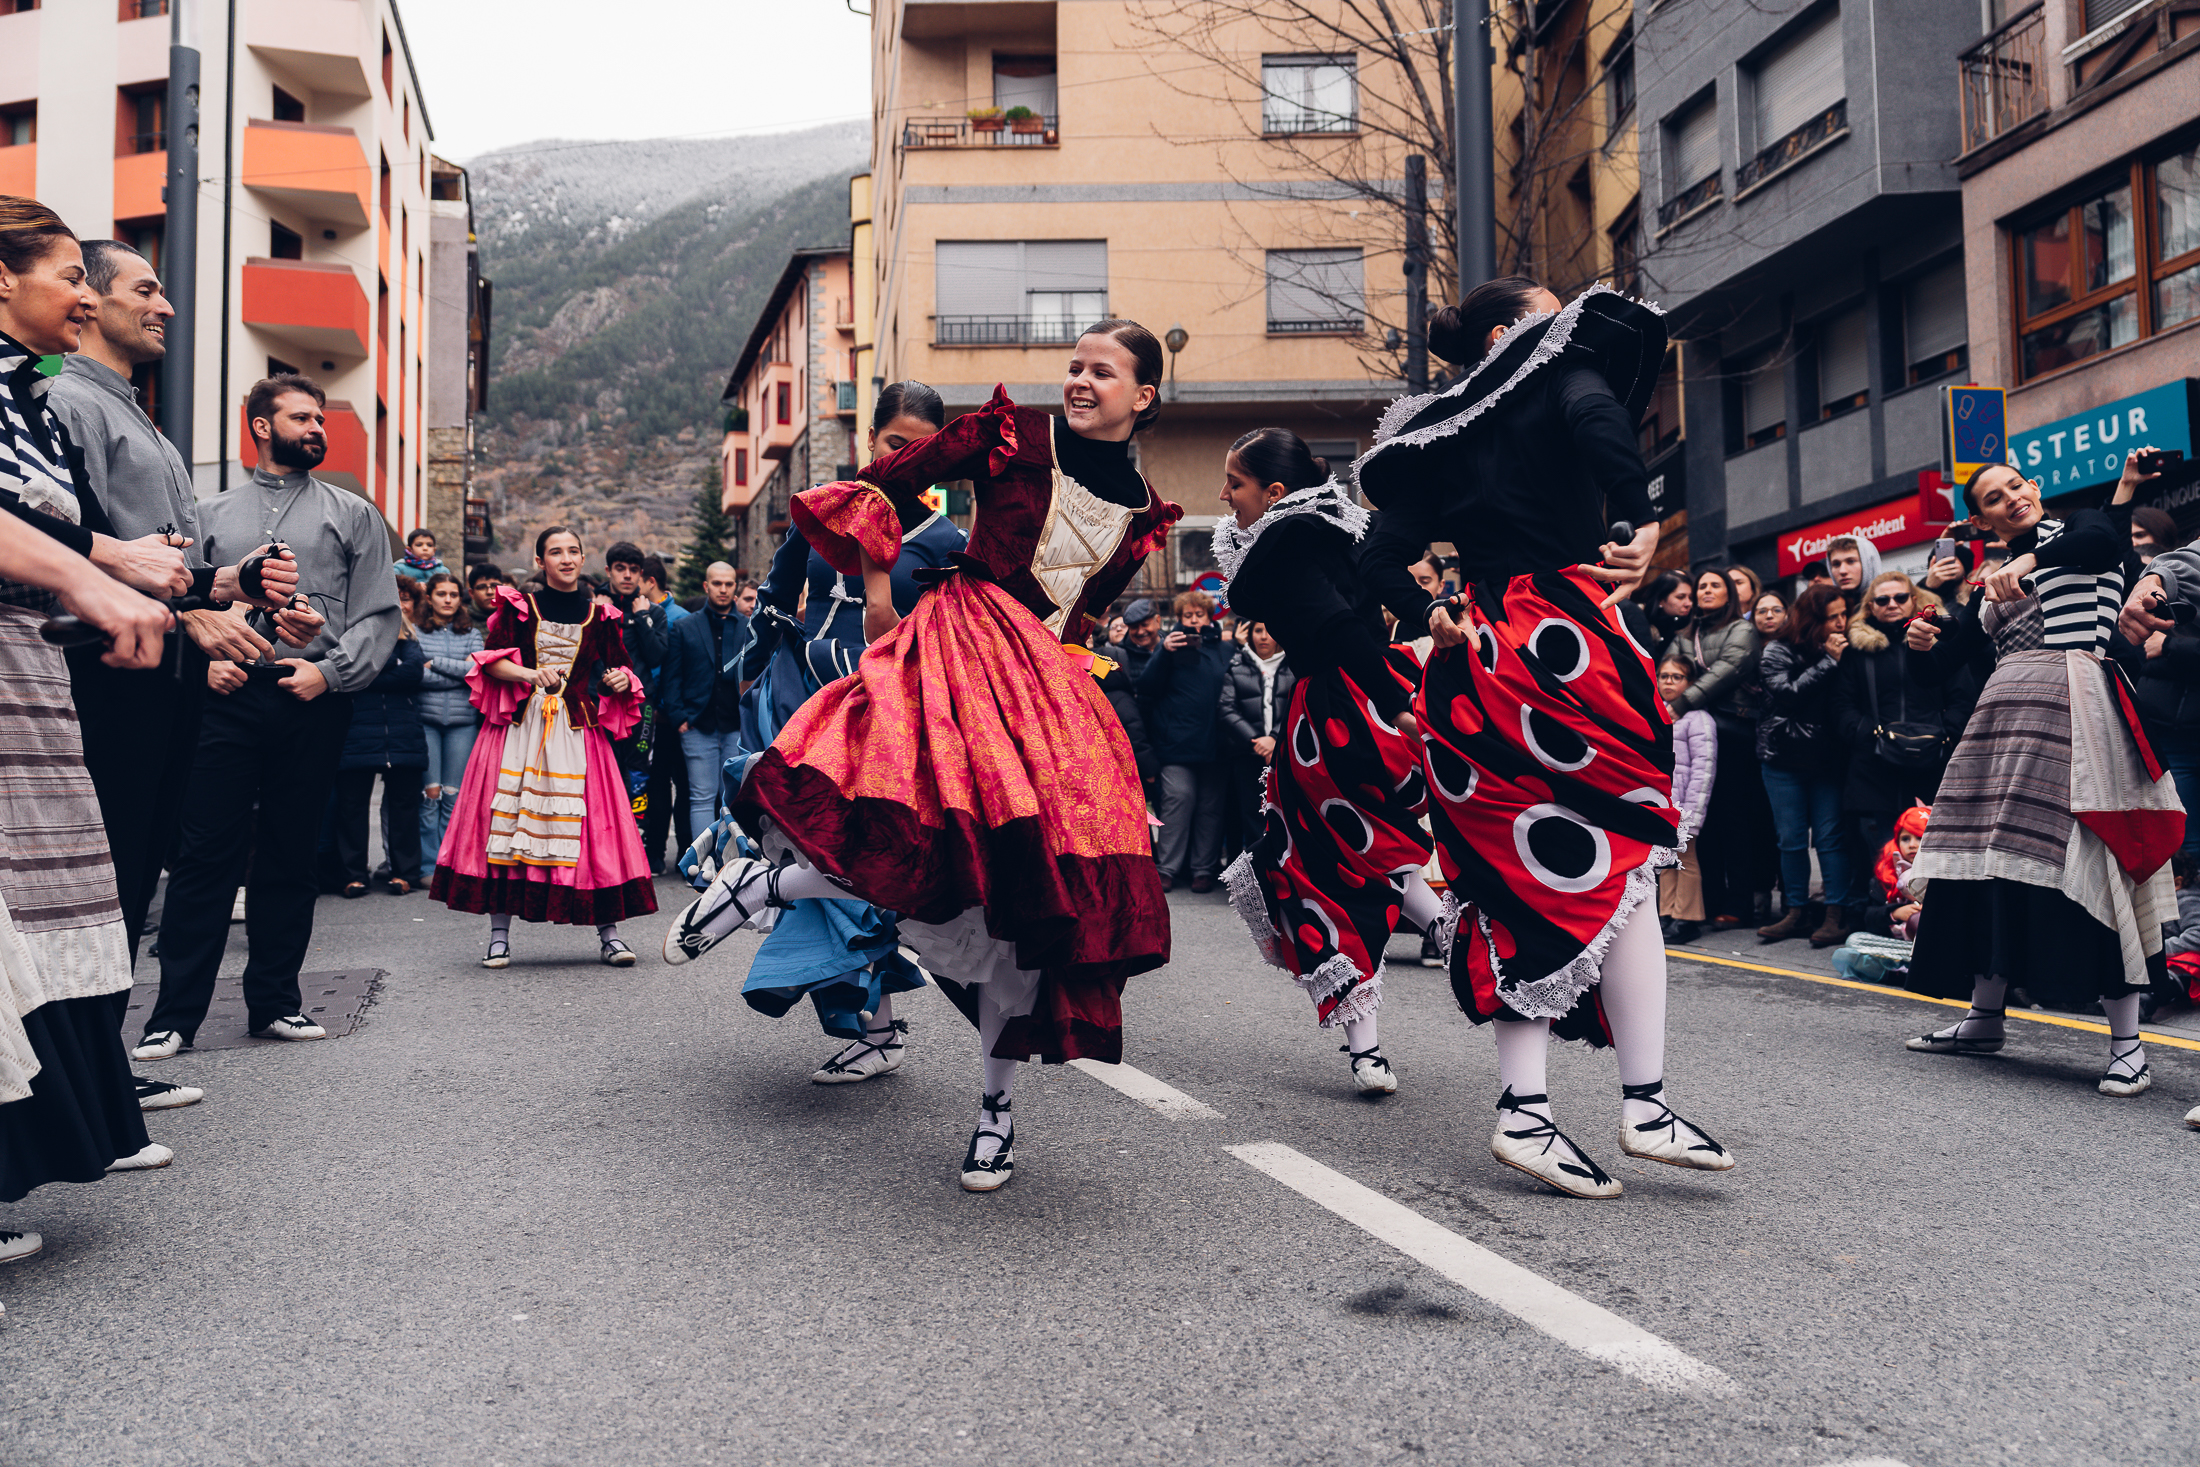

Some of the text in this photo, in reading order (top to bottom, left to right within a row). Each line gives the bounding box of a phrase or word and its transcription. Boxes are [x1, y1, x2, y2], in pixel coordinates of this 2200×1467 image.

[2008, 407, 2148, 471] ASTEUR
[1803, 514, 1907, 557] Catal Occident
